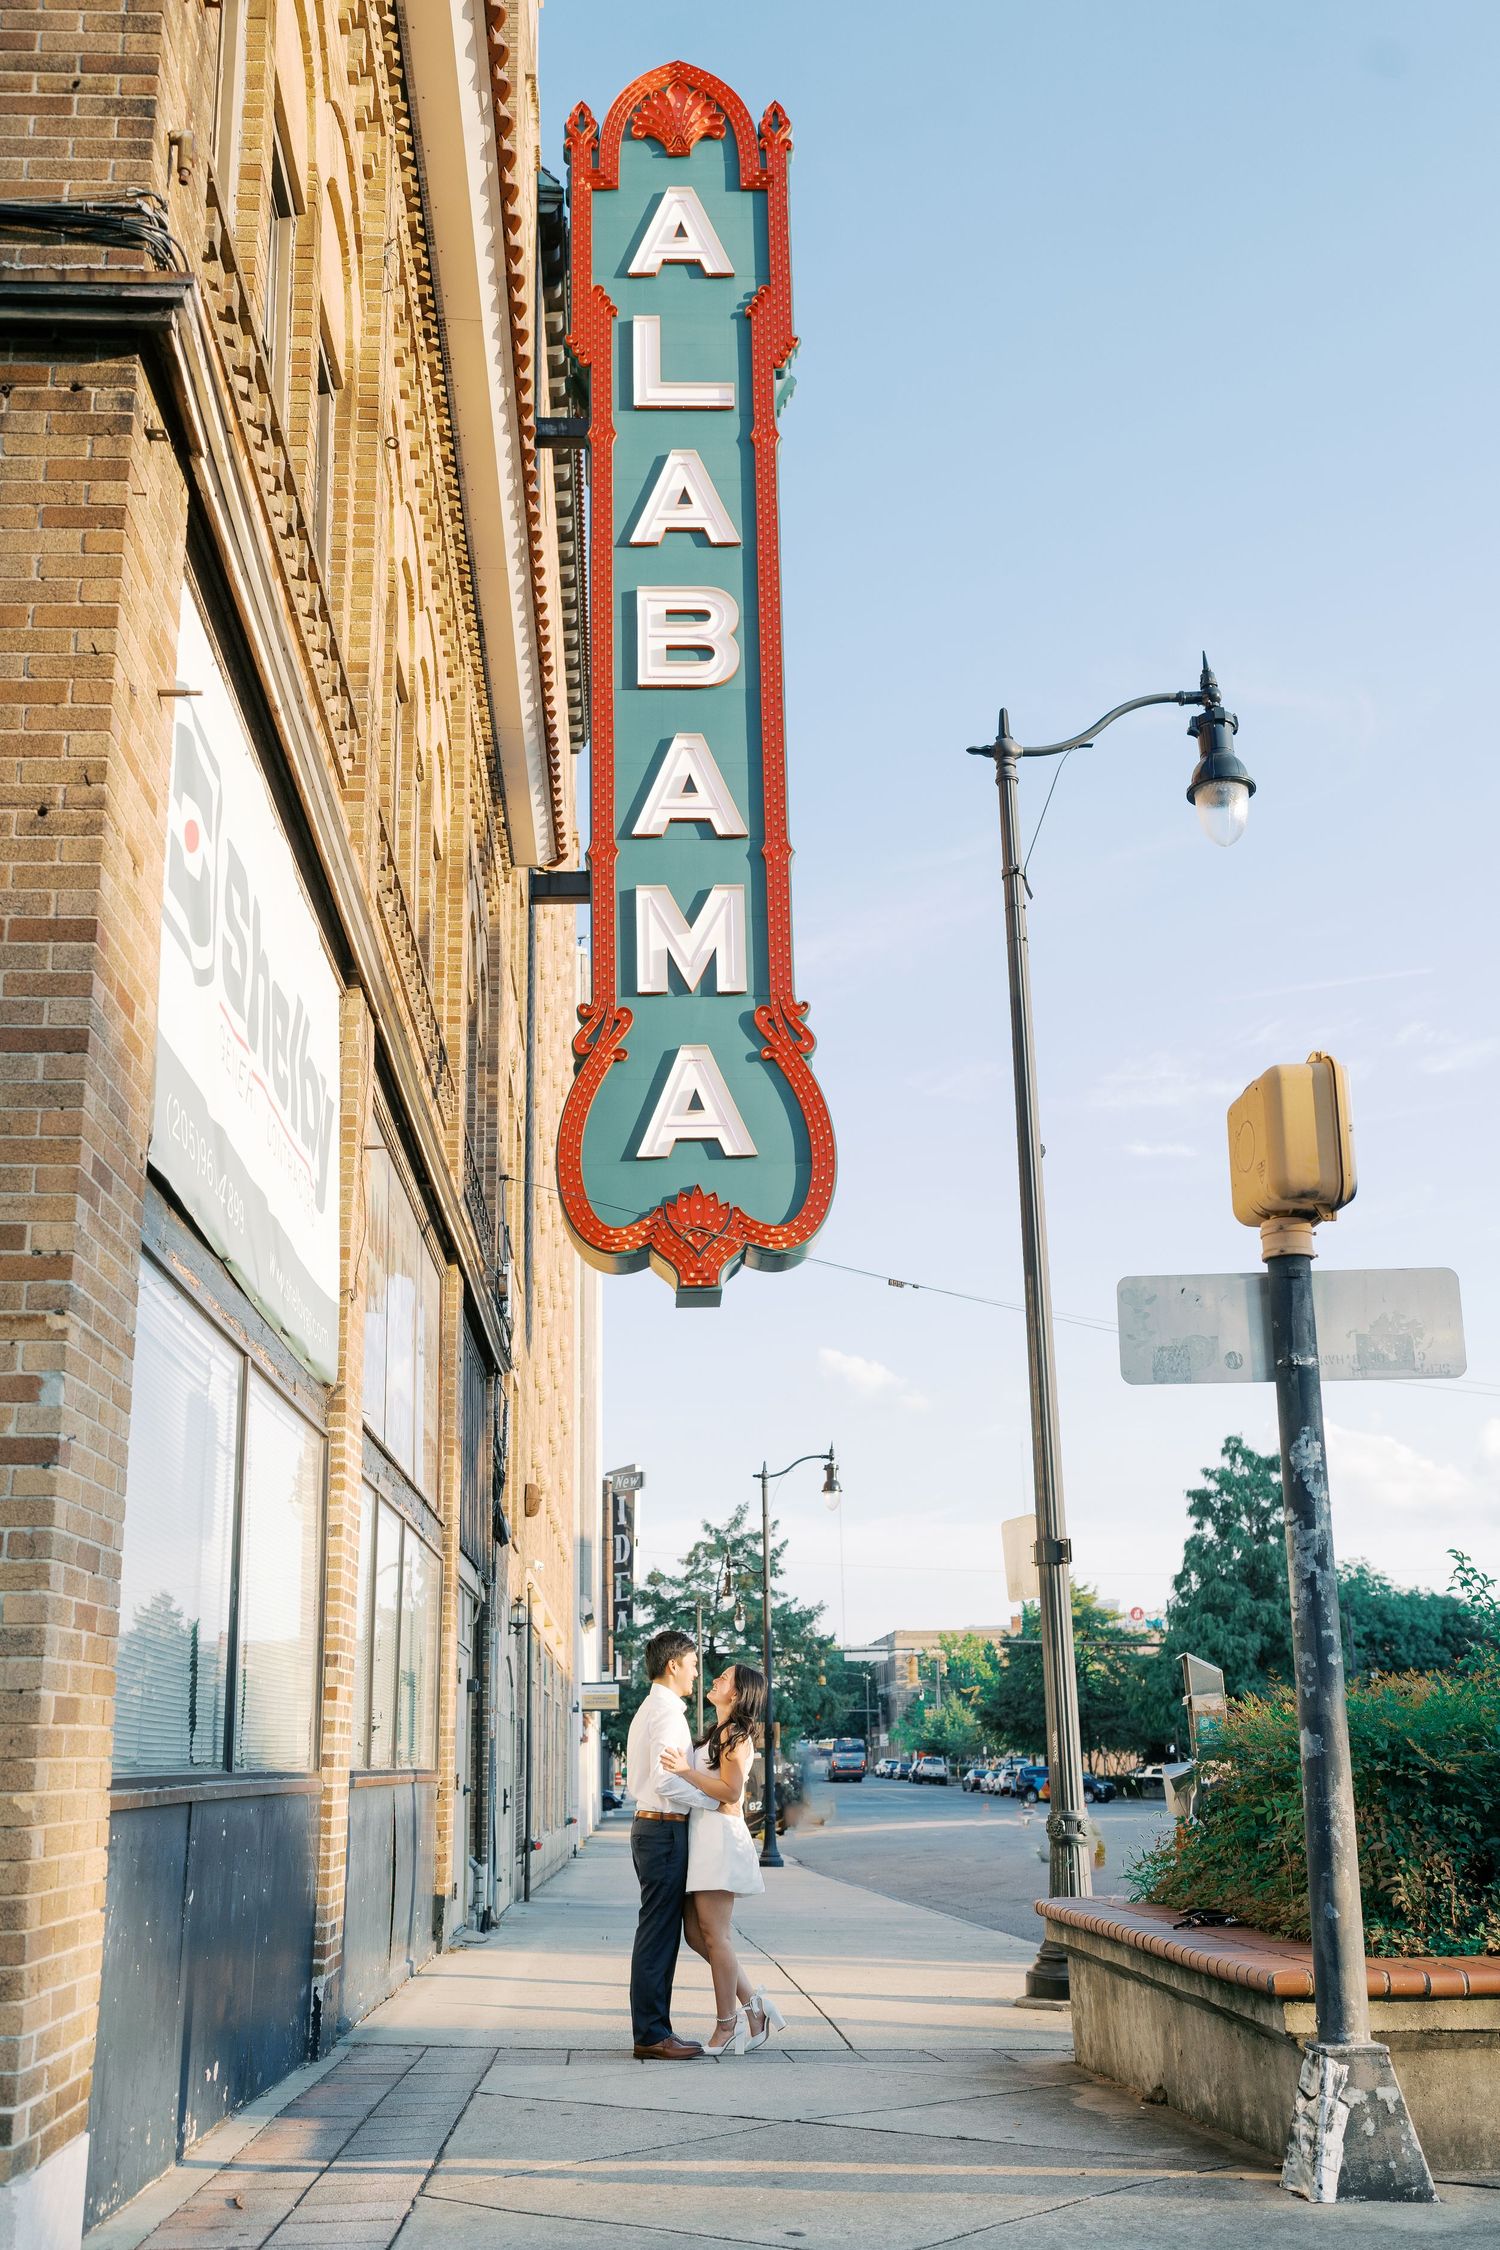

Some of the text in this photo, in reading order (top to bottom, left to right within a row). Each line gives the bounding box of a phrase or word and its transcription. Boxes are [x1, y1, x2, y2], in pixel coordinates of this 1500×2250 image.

[627, 186, 759, 1160] ALABAMA
[222, 838, 337, 1215] Shelby
[613, 1495, 631, 1681] IDEAL
[614, 1475, 640, 1490] New
